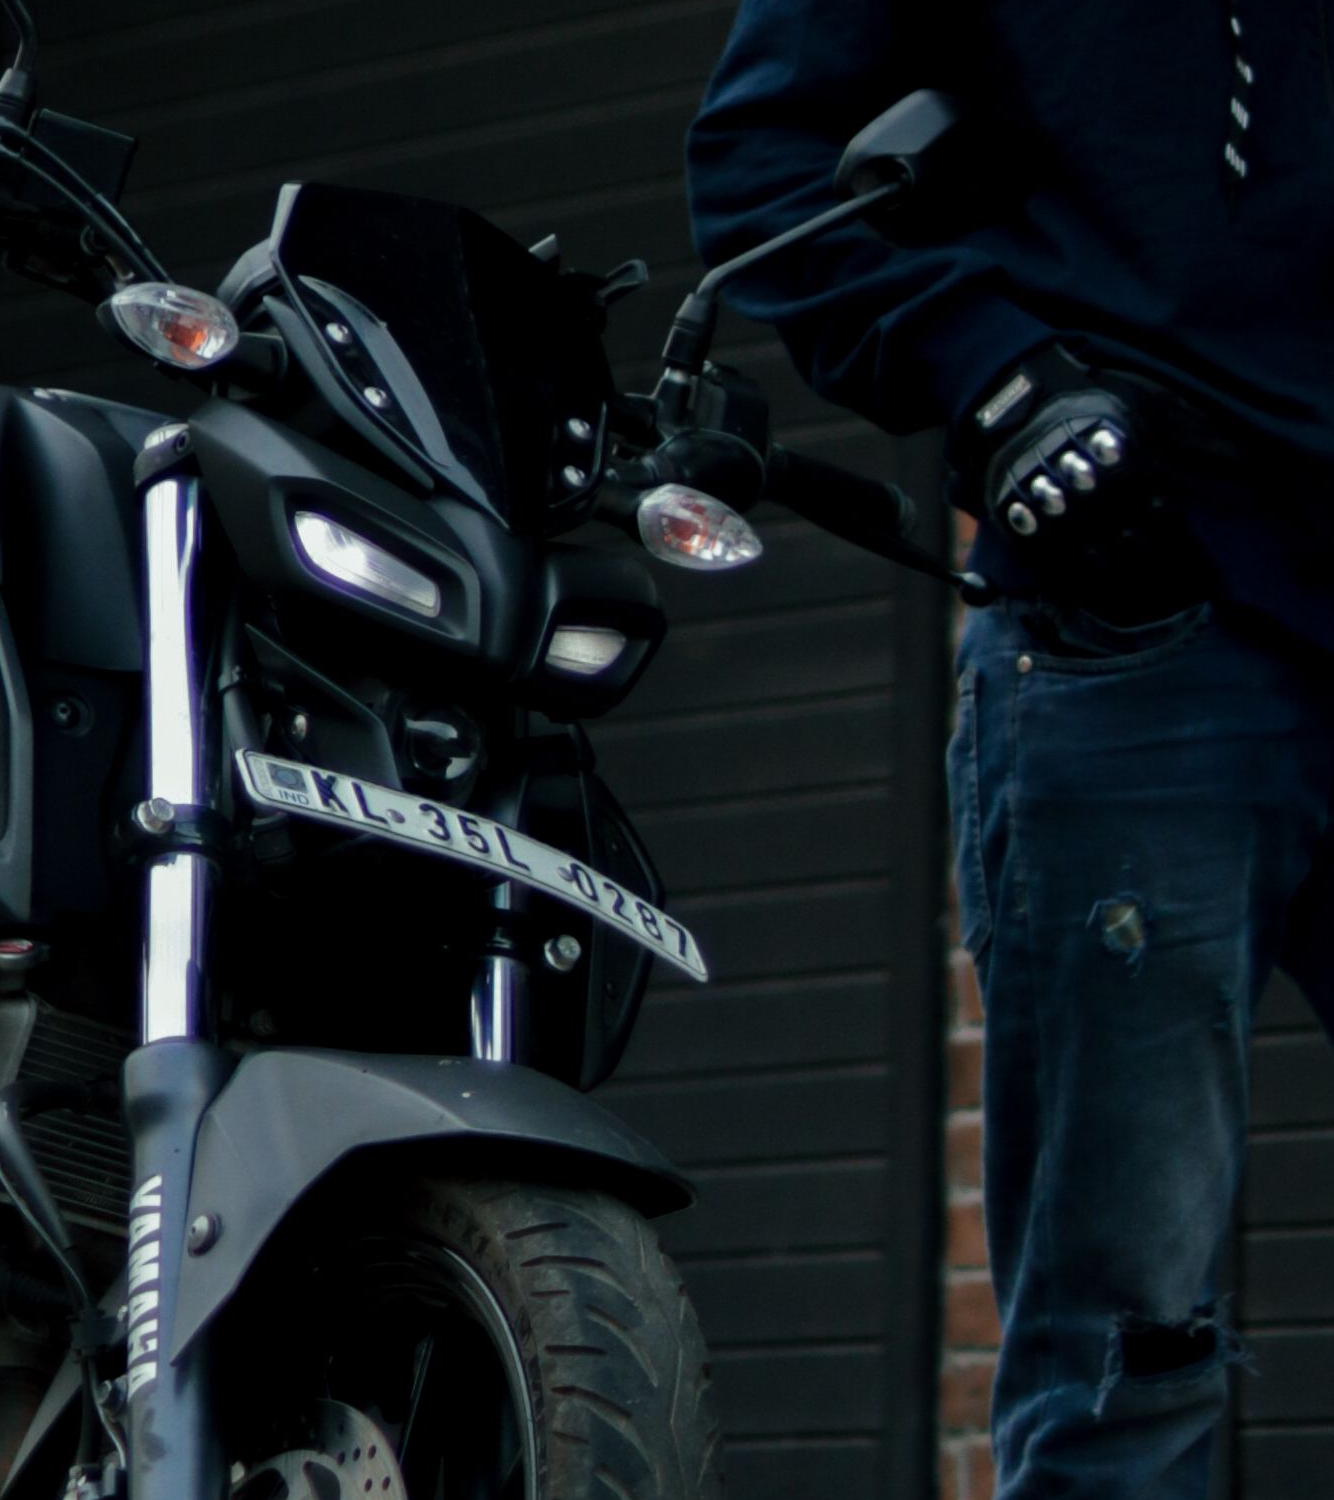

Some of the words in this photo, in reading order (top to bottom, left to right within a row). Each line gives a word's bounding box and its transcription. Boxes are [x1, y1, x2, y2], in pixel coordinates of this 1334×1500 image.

[278, 788, 309, 806] IND
[311, 769, 388, 826] KL
[420, 802, 530, 872] 35L
[570, 861, 689, 959] 0287
[127, 1174, 162, 1402] YAMAHA
